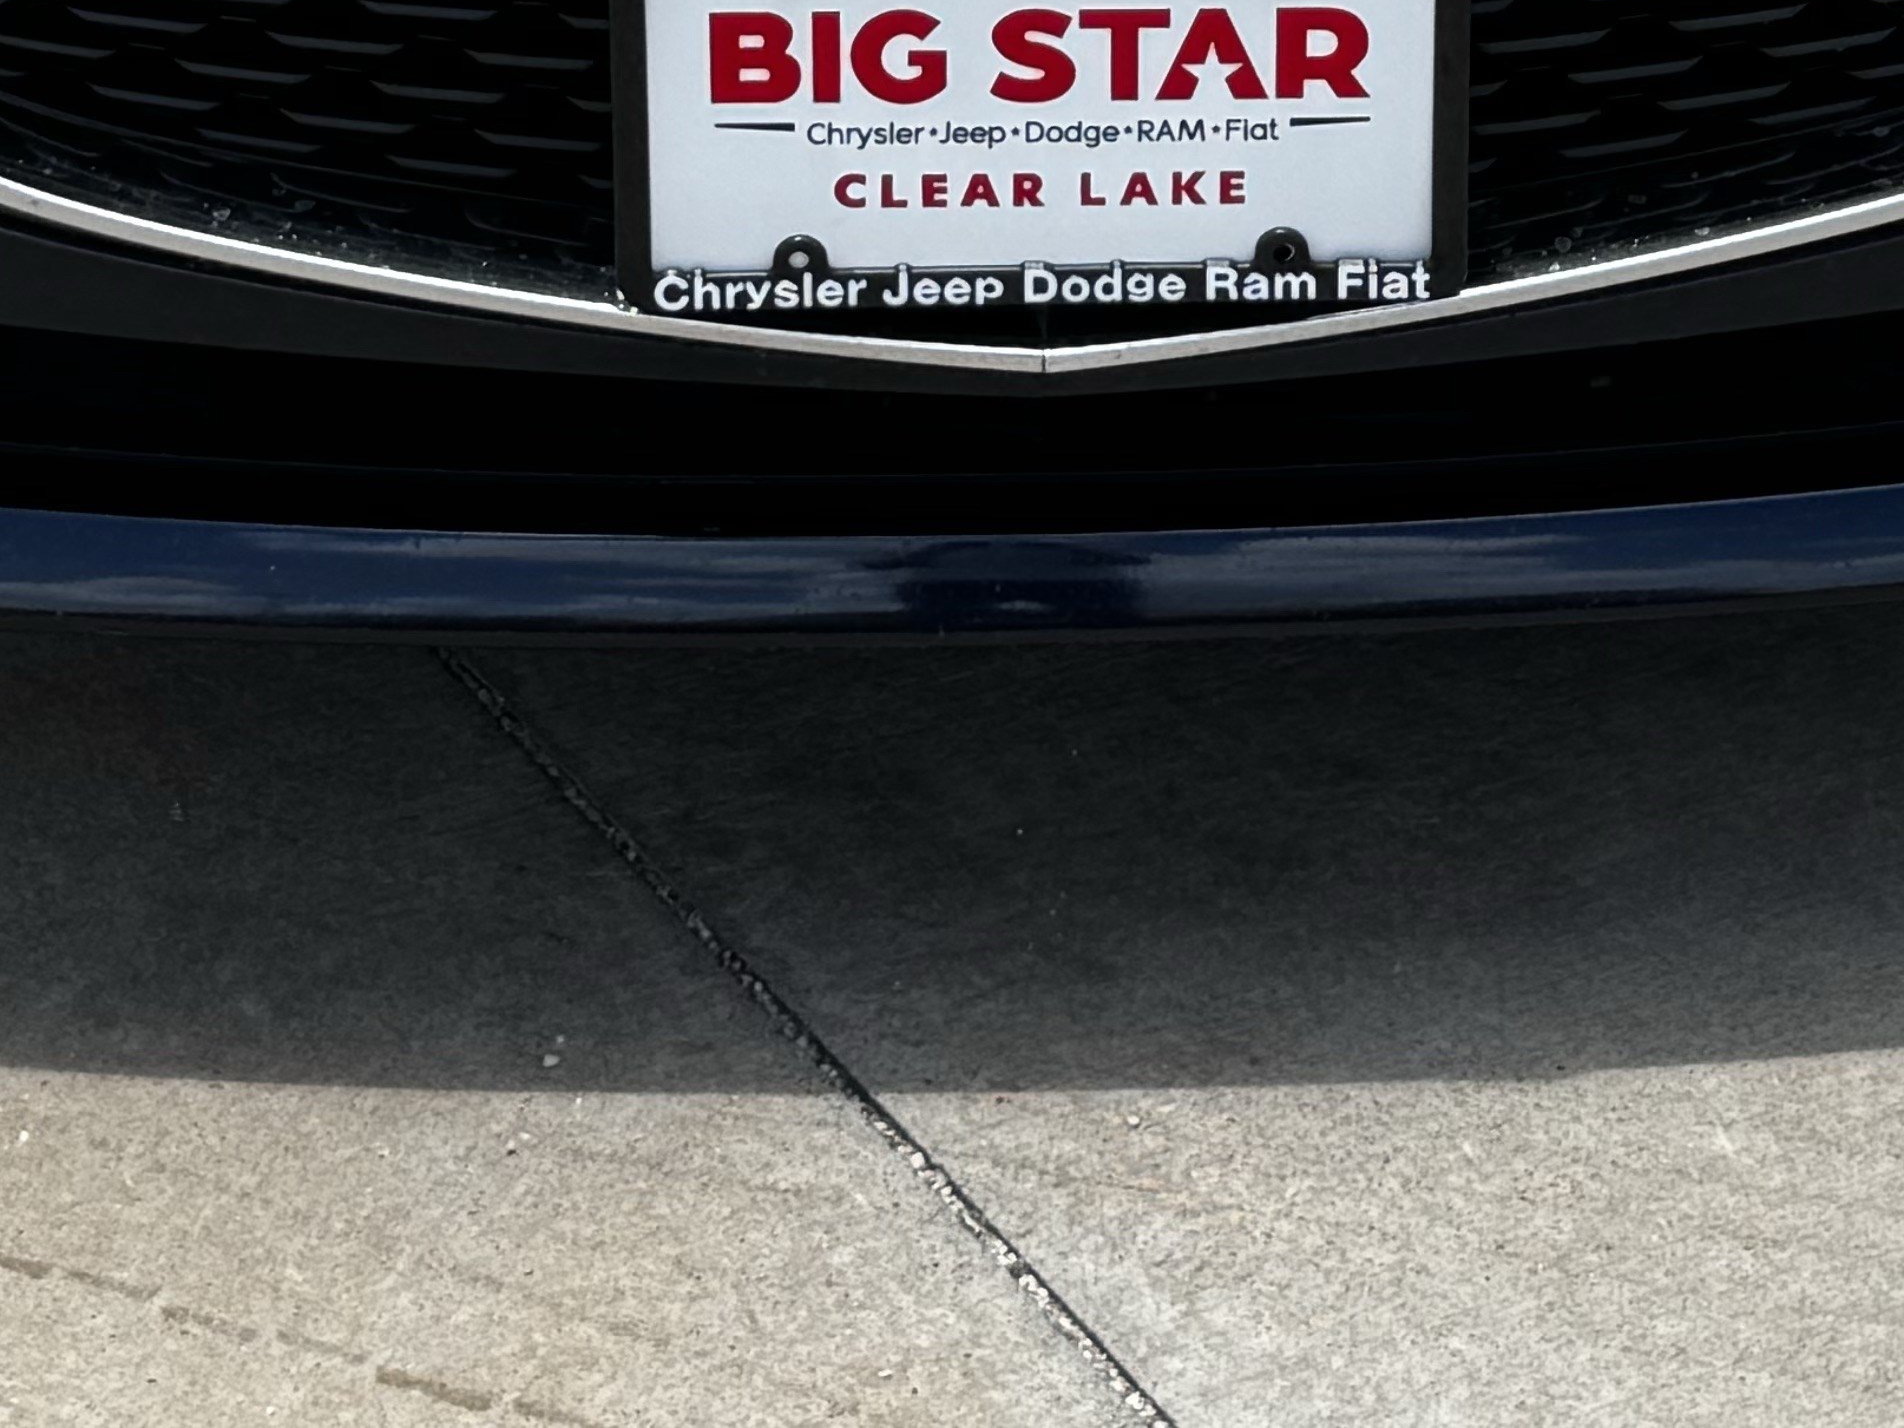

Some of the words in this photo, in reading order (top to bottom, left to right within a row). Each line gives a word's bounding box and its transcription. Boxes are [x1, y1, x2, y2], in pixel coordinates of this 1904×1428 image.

[709, 9, 947, 105] BIG
[990, 7, 1371, 104] STAR
[806, 121, 925, 150] Chrysler
[938, 120, 1007, 149] Jeep
[1024, 119, 1120, 148] Dodge
[1136, 119, 1205, 143] RAM
[833, 173, 1045, 209] CLEAR
[1080, 170, 1246, 207] LAKE
[653, 270, 868, 312] Chrysler
[882, 263, 1005, 307] Jeep
[1023, 260, 1187, 304] Dodge
[1205, 259, 1317, 301] Ram
[1337, 258, 1431, 300] Fiat
